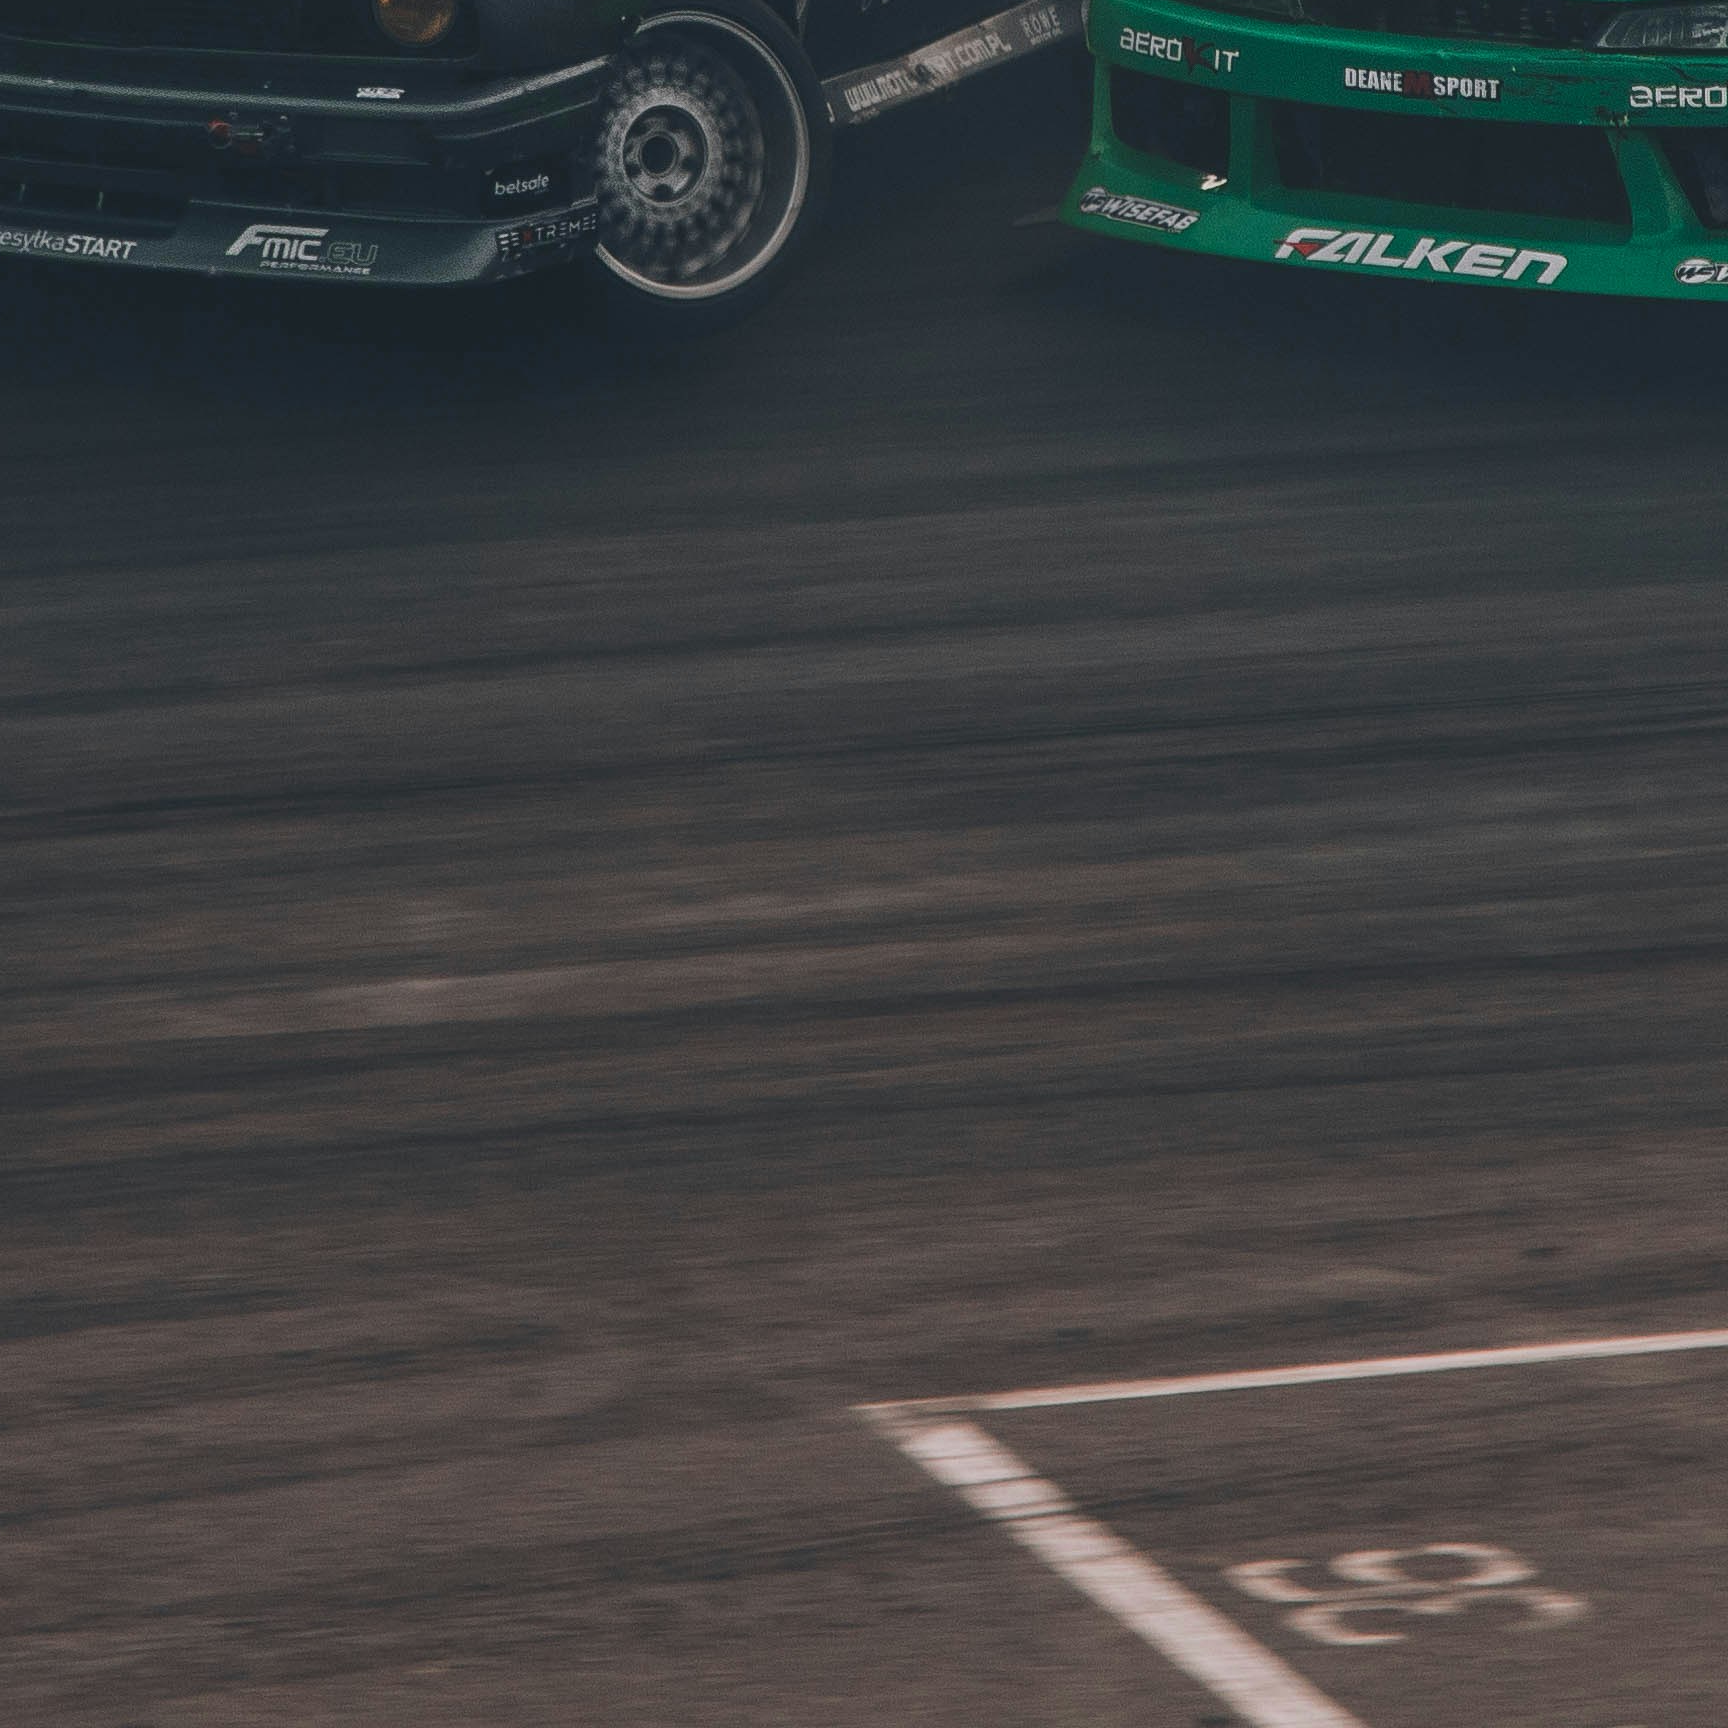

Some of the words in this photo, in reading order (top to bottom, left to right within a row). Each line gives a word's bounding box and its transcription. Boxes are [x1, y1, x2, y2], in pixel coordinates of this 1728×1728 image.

[1021, 6, 1060, 38] ROWE
[1344, 67, 1403, 92] DEANE
[1433, 75, 1501, 99] SPORT
[495, 174, 550, 195] betsafe
[1106, 197, 1200, 231] WISEFAB
[259, 260, 372, 275] PERFORMANCE
[1274, 227, 1568, 285] FALKEN
